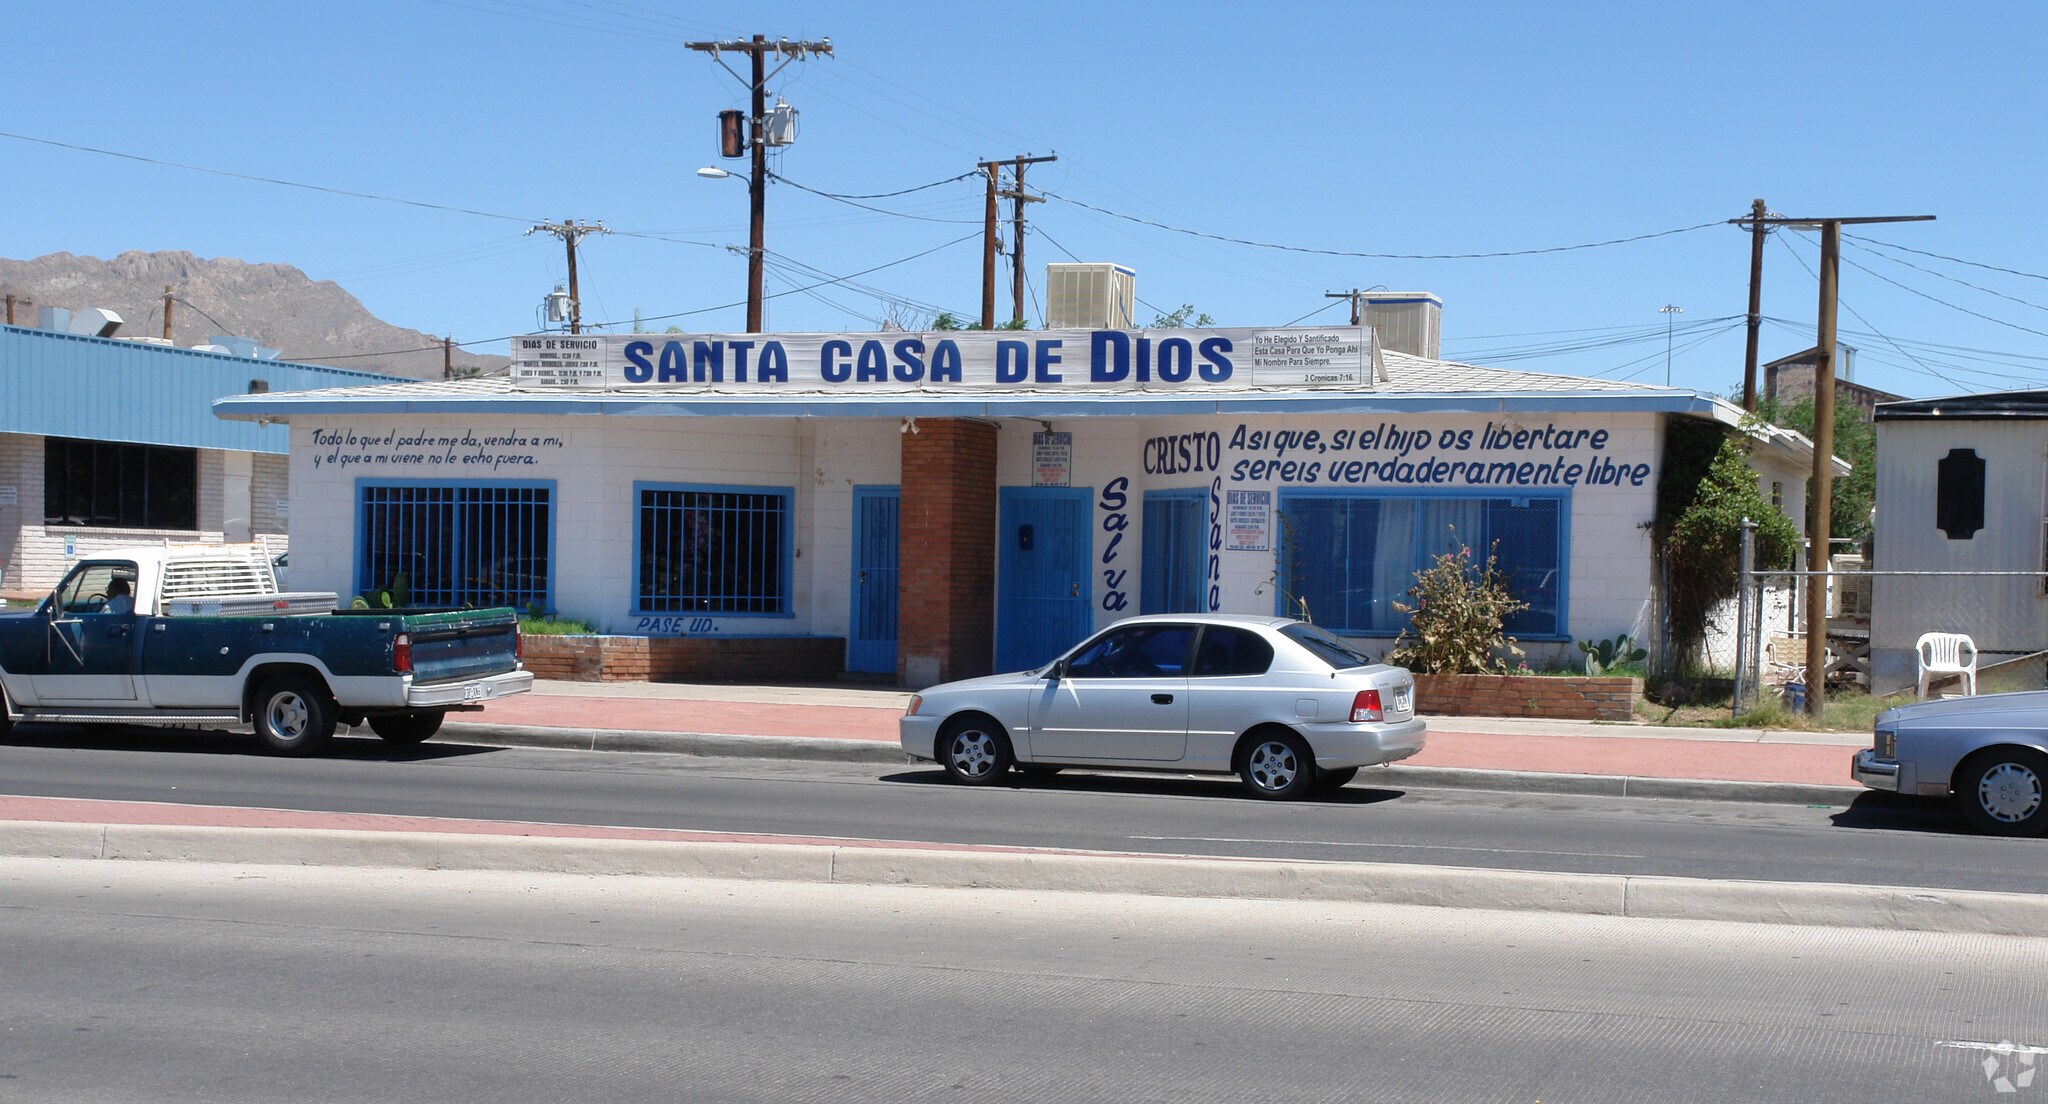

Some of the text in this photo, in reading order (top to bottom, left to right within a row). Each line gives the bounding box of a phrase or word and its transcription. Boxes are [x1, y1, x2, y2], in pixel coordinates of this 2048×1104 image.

[523, 340, 597, 349] DIAS DE SERVICIO
[1255, 347, 1268, 355] Esta
[1270, 346, 1285, 354] Casa
[1287, 346, 1300, 354] Para
[1302, 346, 1314, 354] Que
[1326, 346, 1345, 355] Ponga
[1274, 335, 1297, 345] Elegido
[624, 331, 1234, 383] SANTA CASA DE DIOS
[1304, 357, 1331, 367] Siempre.
[312, 429, 563, 450] Todo lo que el padre me da, vendra a mi,
[1274, 430, 1326, 457] que,
[1330, 429, 1355, 450] si
[1359, 423, 1385, 450] el
[1384, 424, 1432, 457] hijo
[1438, 429, 1473, 450] os
[1480, 422, 1608, 450] libertare
[314, 454, 321, 468] y
[327, 447, 339, 463] el
[340, 454, 361, 468] que
[375, 454, 388, 463] mi
[392, 454, 424, 464] viene
[428, 455, 442, 464] no
[445, 447, 457, 464] le
[463, 447, 493, 464] echo
[494, 455, 538, 471] fuera.
[1144, 431, 1221, 474] CRISTO
[1230, 456, 1650, 486] sereis verdaderamente libre
[1099, 476, 1129, 612] Salva
[1208, 476, 1222, 612] Sana
[636, 617, 684, 632] PASE
